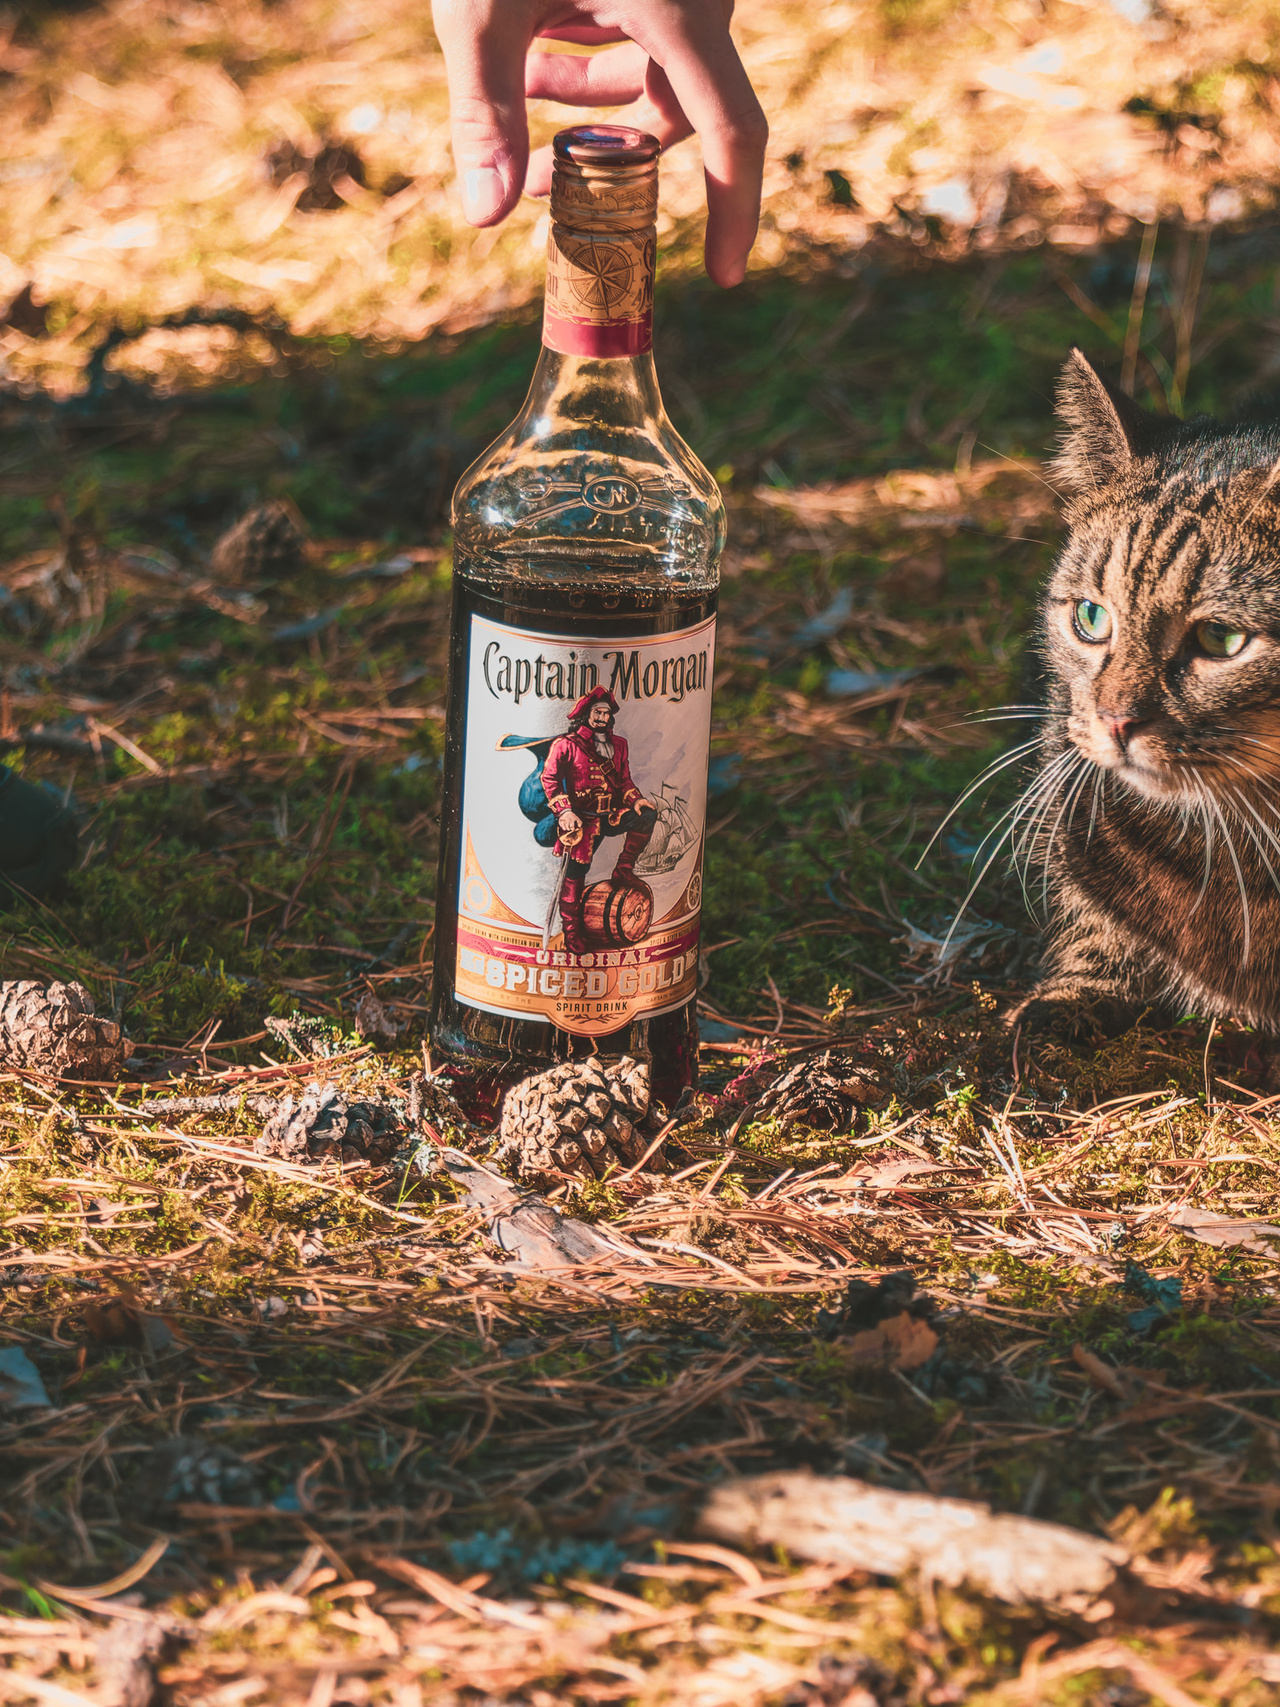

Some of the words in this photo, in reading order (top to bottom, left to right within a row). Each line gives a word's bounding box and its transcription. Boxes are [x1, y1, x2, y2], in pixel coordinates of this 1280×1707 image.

[482, 641, 599, 703] Captain
[602, 648, 708, 703] Morgan
[500, 935, 527, 947] CARIBBEAN
[535, 948, 652, 968] ORIGINAL
[485, 958, 607, 999] SPICED
[618, 956, 685, 996] GOLD
[515, 996, 533, 1005] THE
[555, 1001, 595, 1013] SPIRIT
[597, 1001, 628, 1013] DRINK
